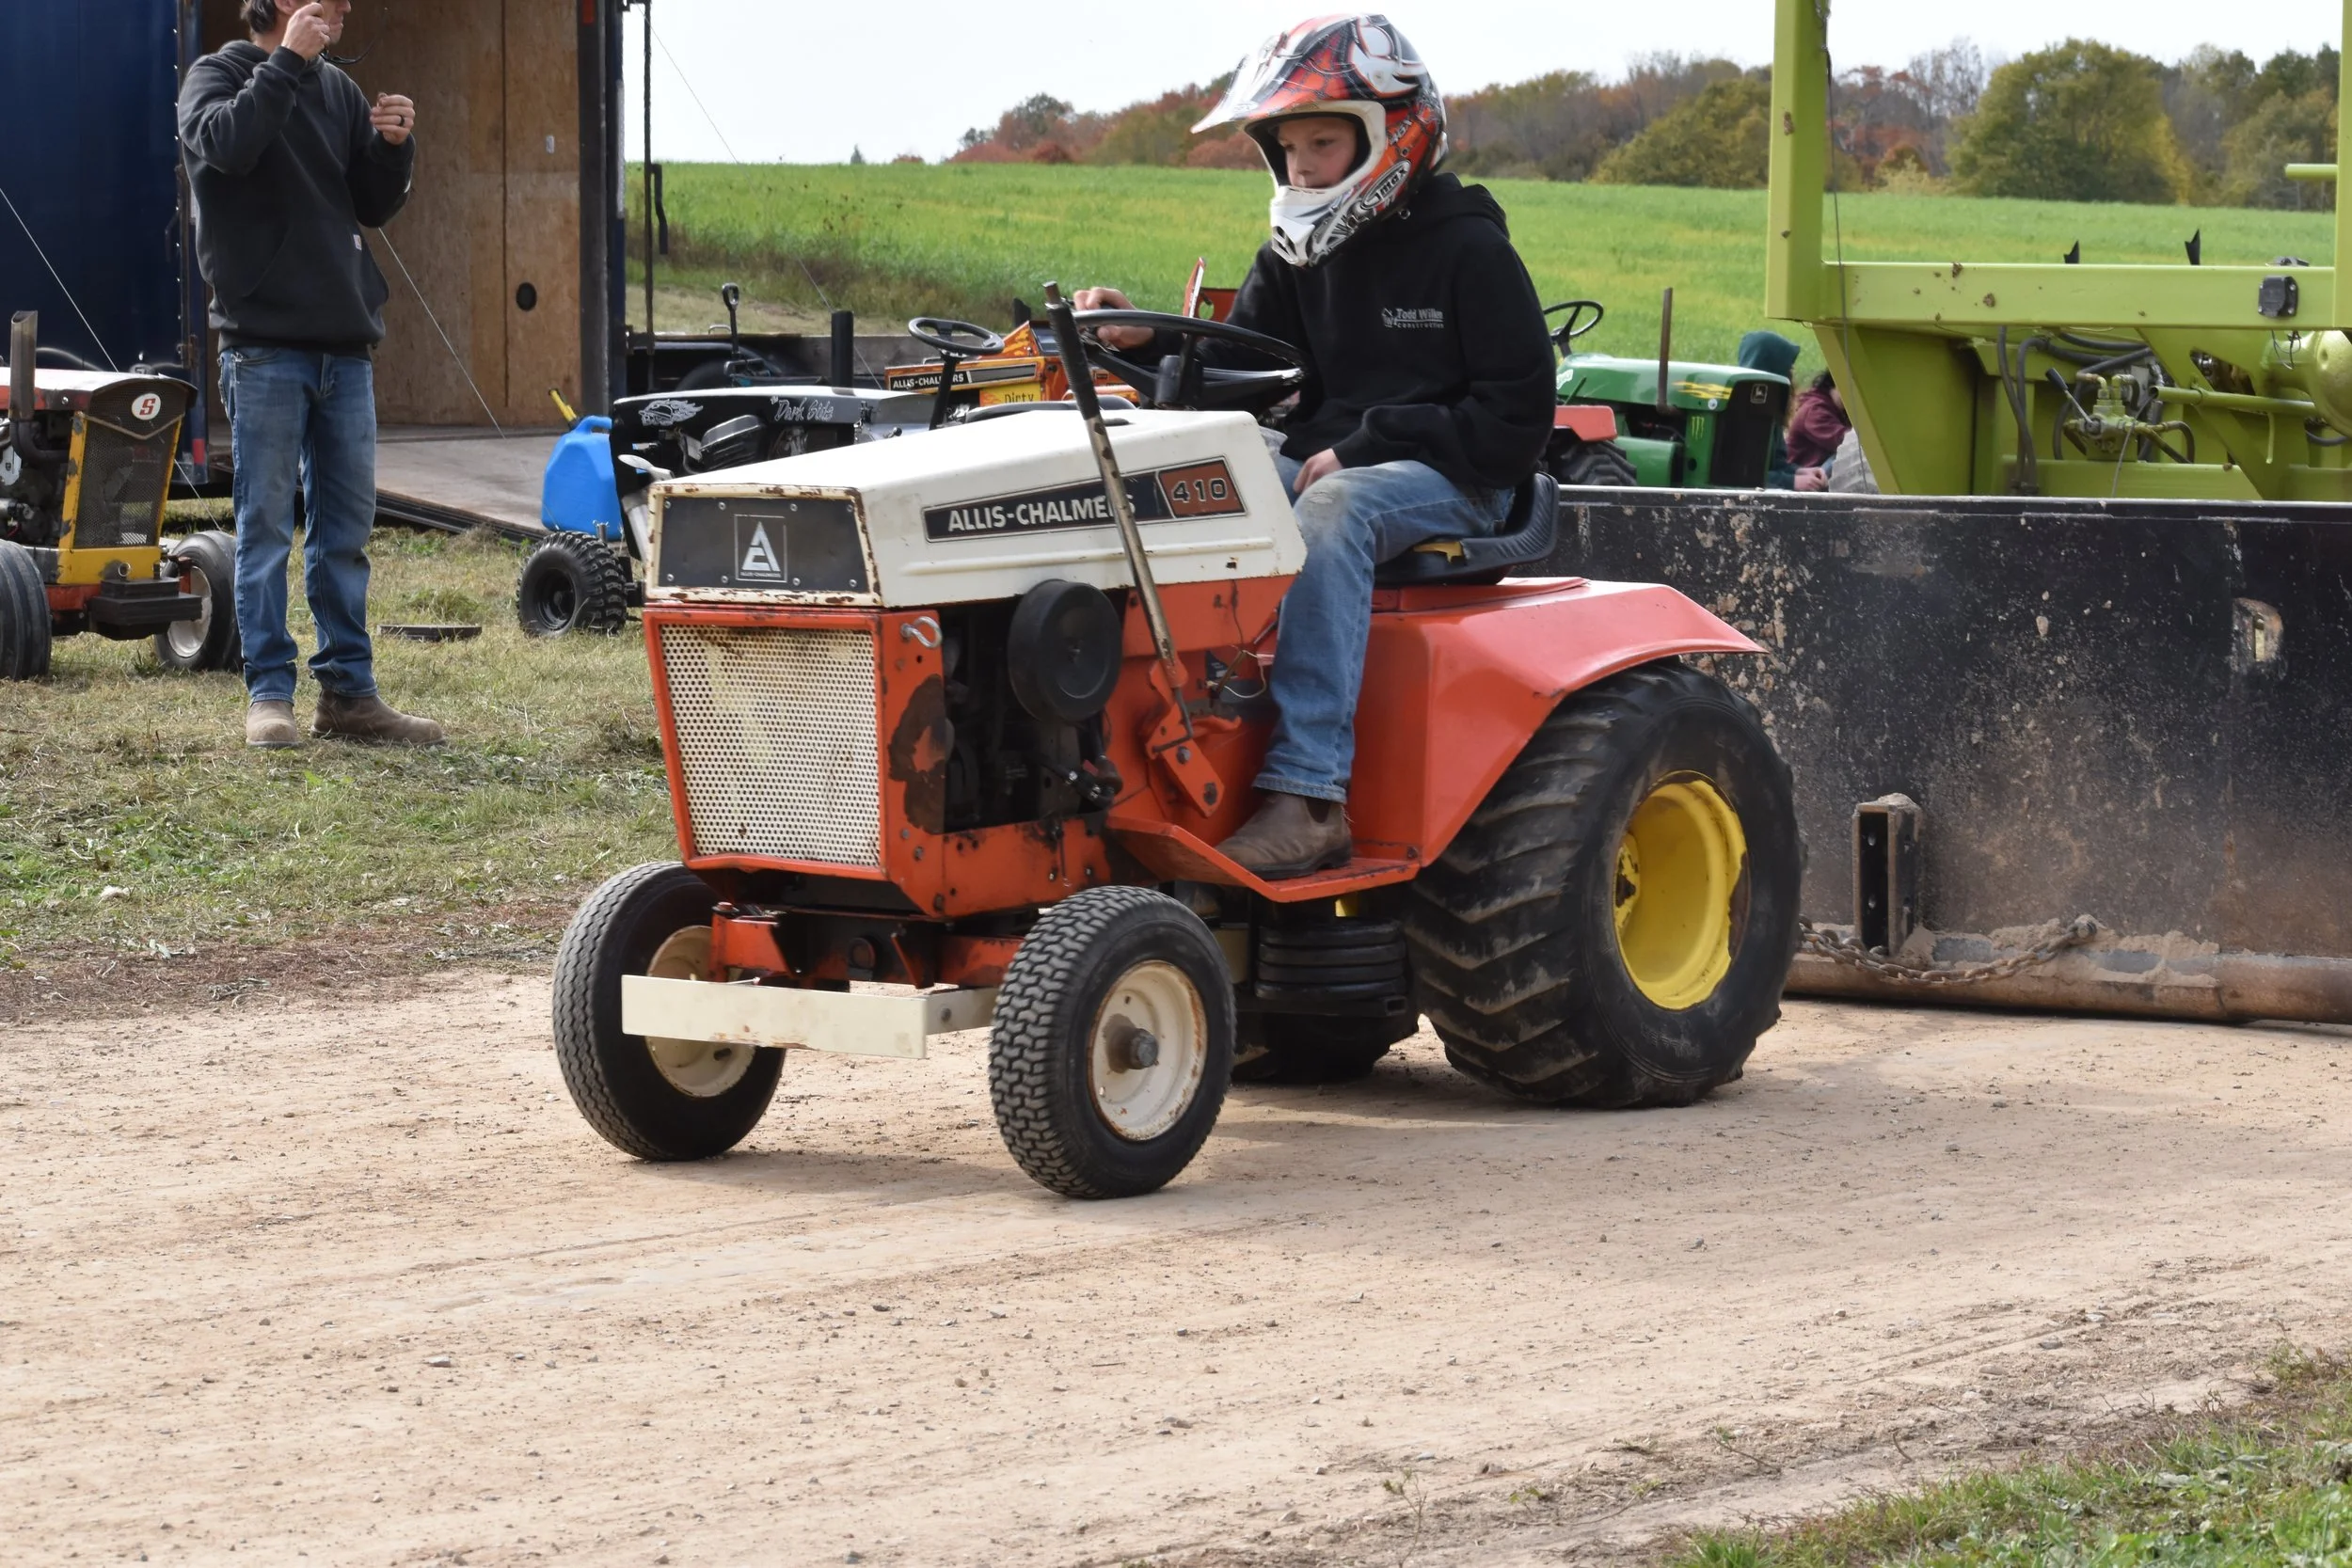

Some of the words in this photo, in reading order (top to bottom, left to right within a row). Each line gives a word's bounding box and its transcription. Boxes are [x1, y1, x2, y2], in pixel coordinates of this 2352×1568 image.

[1395, 308, 1417, 320] Todd
[893, 372, 964, 389] ALLIS-CHALRS
[139, 398, 156, 416] S
[1173, 478, 1228, 502] 410
